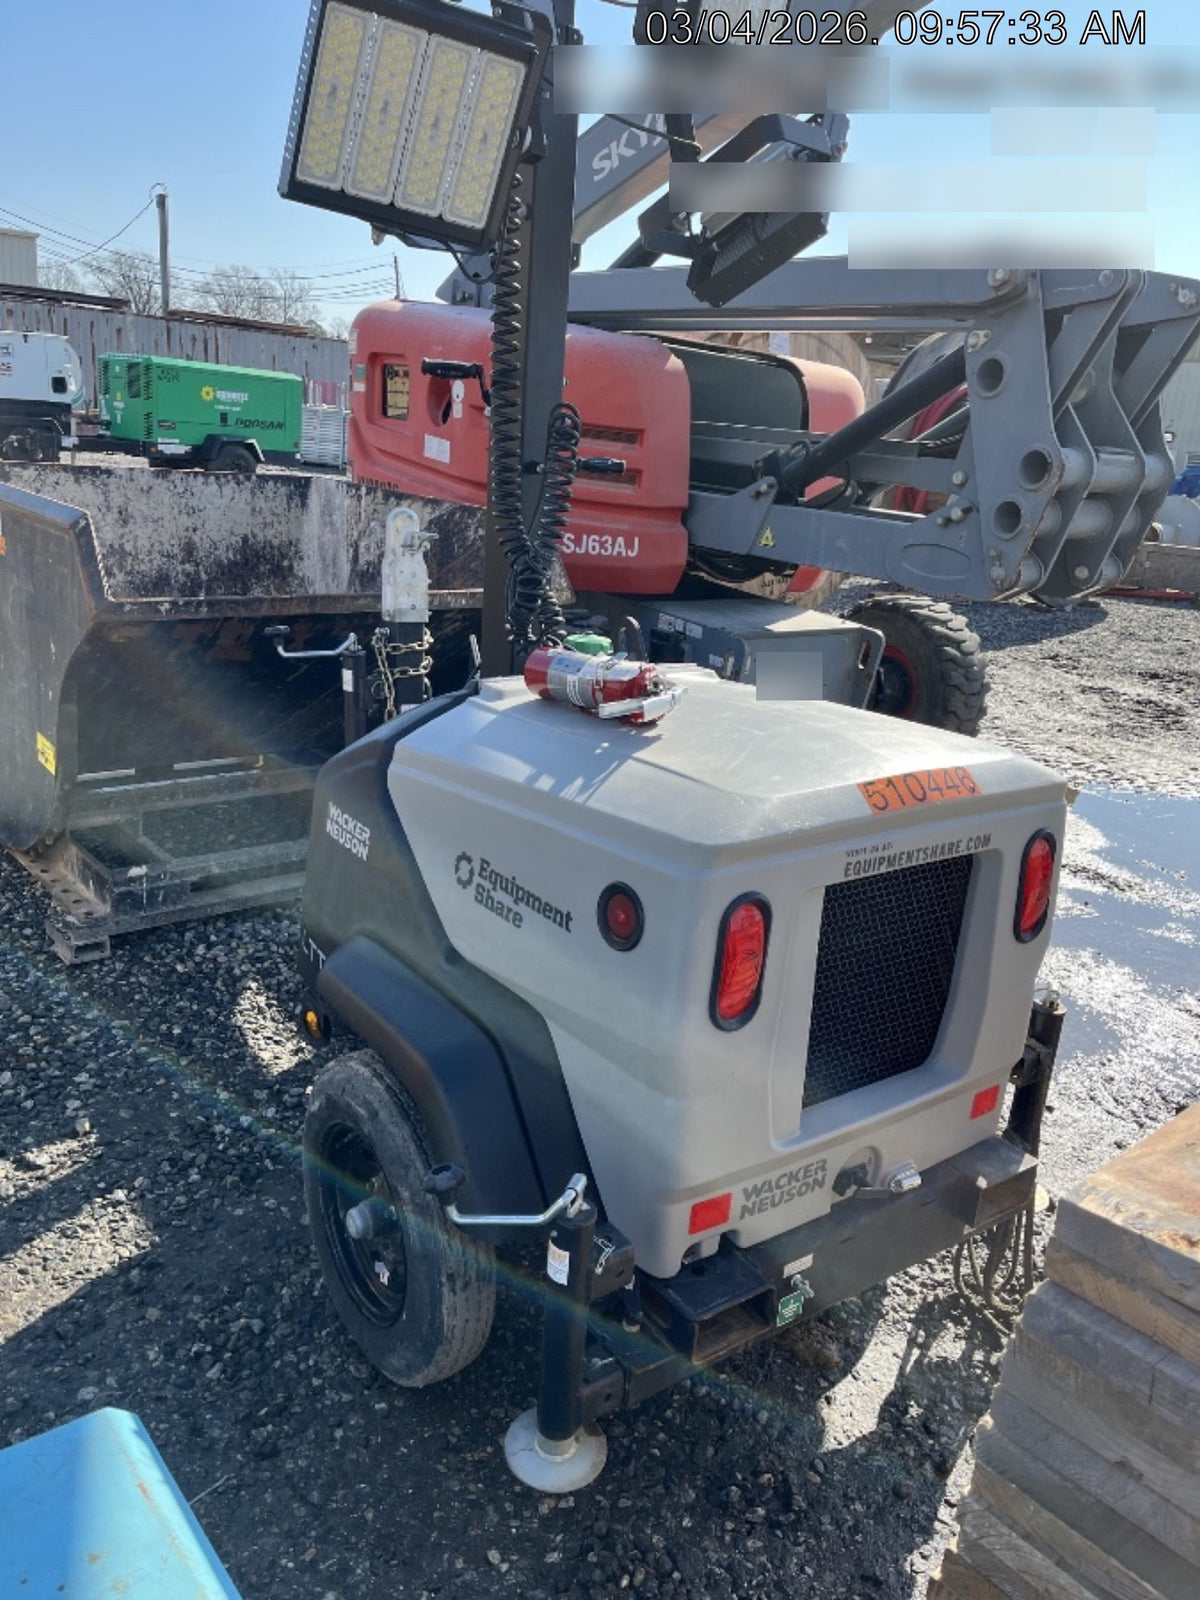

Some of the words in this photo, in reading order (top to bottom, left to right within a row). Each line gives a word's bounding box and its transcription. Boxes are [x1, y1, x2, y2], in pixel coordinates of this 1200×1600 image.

[562, 532, 640, 558] SJ63AJ
[863, 765, 976, 812] 510446
[326, 818, 369, 862] NEUSON
[328, 802, 371, 842] WACKER
[843, 833, 992, 879] EQUIPMENTSHARE.COM
[474, 882, 523, 929] Share
[478, 857, 573, 933] Equipment
[738, 1173, 827, 1220] NEUSON
[742, 1158, 828, 1201] WACKER
